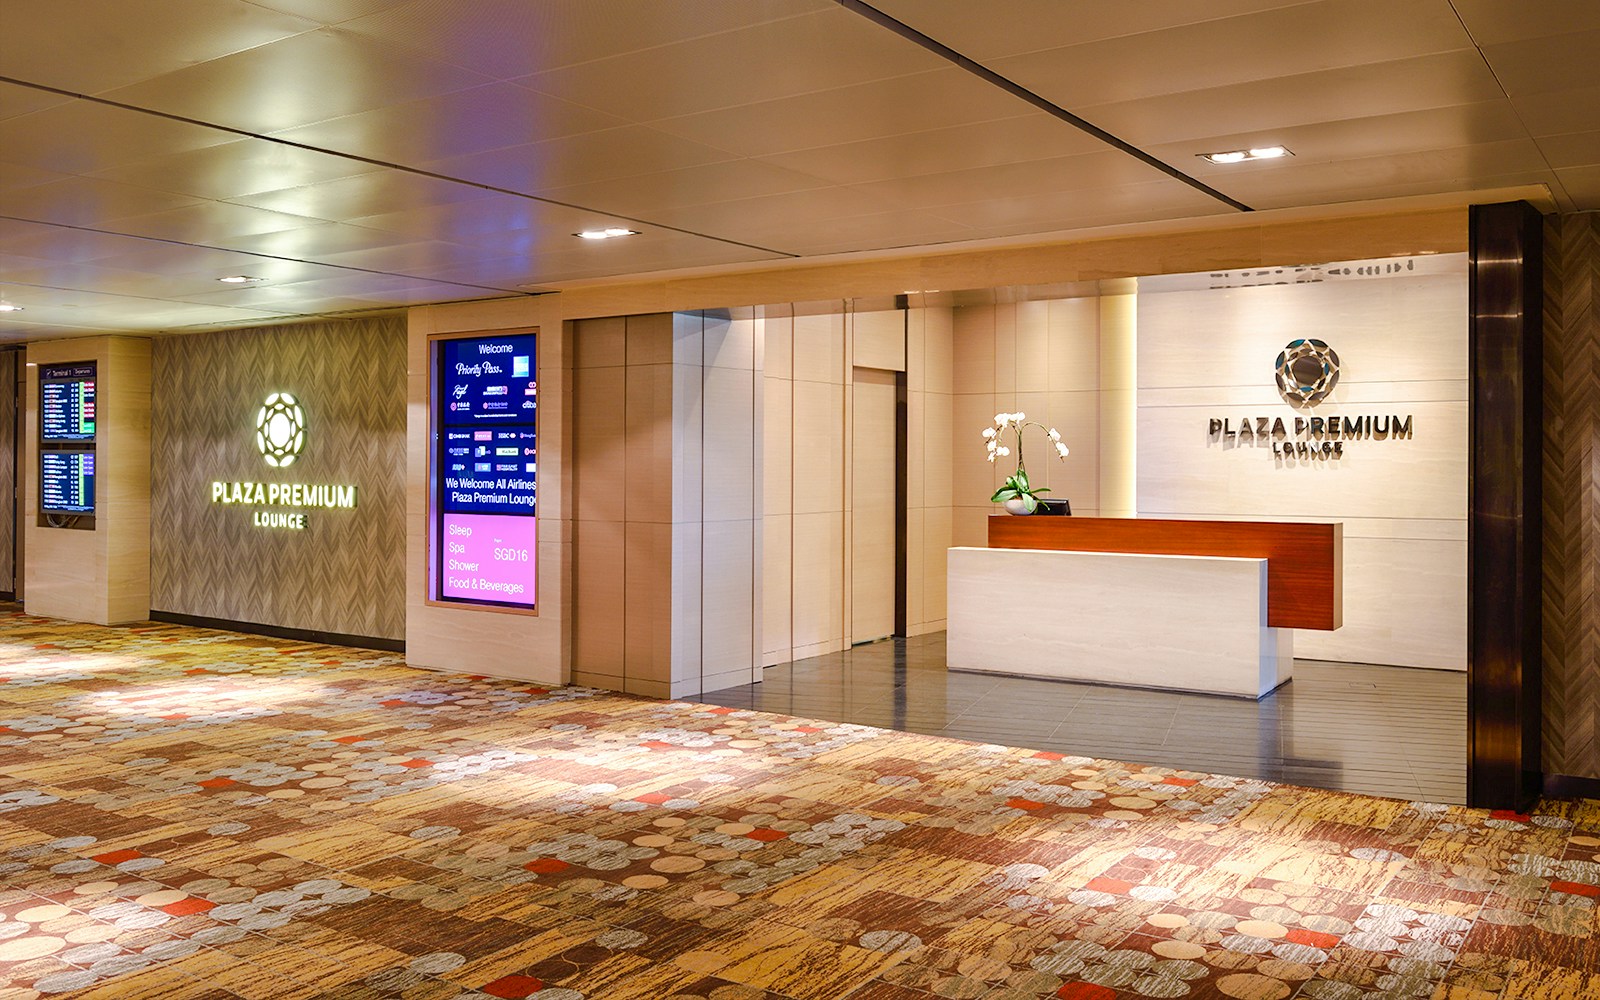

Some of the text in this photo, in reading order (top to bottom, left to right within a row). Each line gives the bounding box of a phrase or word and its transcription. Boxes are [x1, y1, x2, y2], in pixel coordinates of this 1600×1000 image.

[478, 344, 514, 354] Welcome
[455, 362, 482, 377] Priority
[1209, 415, 1413, 436] PLAZA PREMIUM
[1272, 442, 1344, 454] LOUNGE
[445, 478, 536, 490] We Welcome All Airlines
[212, 482, 355, 508] PLAZA PREMIUM
[452, 491, 472, 502] Plaza
[474, 492, 508, 504] Premium
[254, 511, 304, 529] LOUNGE
[449, 524, 472, 538] Sleep
[449, 541, 465, 555] Spa
[494, 548, 528, 562] SGD16
[448, 559, 479, 571] Shower
[448, 577, 524, 594] Food & Beverages
